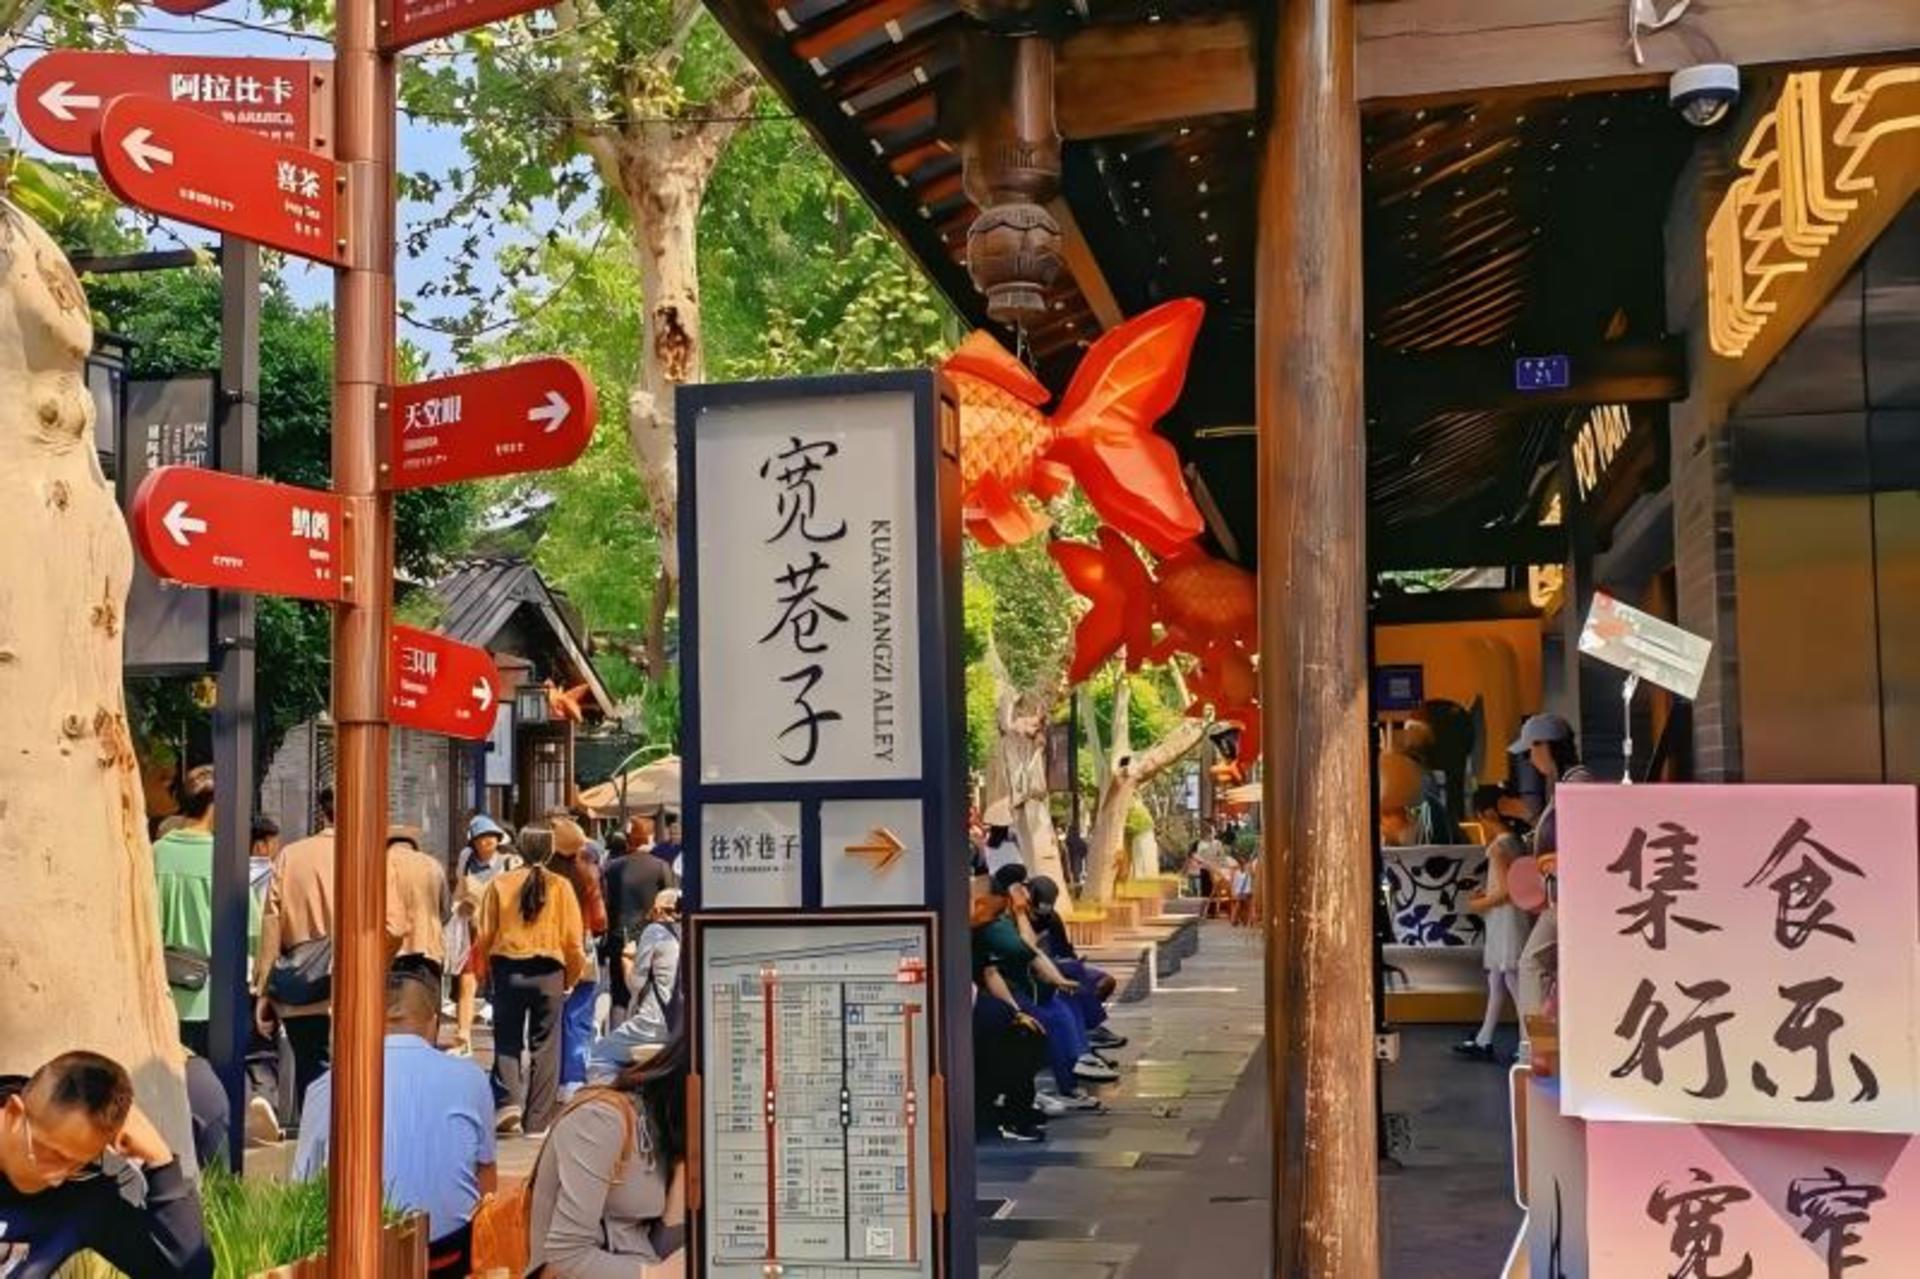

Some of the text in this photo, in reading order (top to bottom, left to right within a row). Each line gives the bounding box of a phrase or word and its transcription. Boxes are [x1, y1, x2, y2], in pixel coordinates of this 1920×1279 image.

[171, 73, 294, 104] 阿拉比卡
[758, 436, 850, 767] 宽巷子
[870, 519, 895, 762] KUANXIANGZI ALLEY
